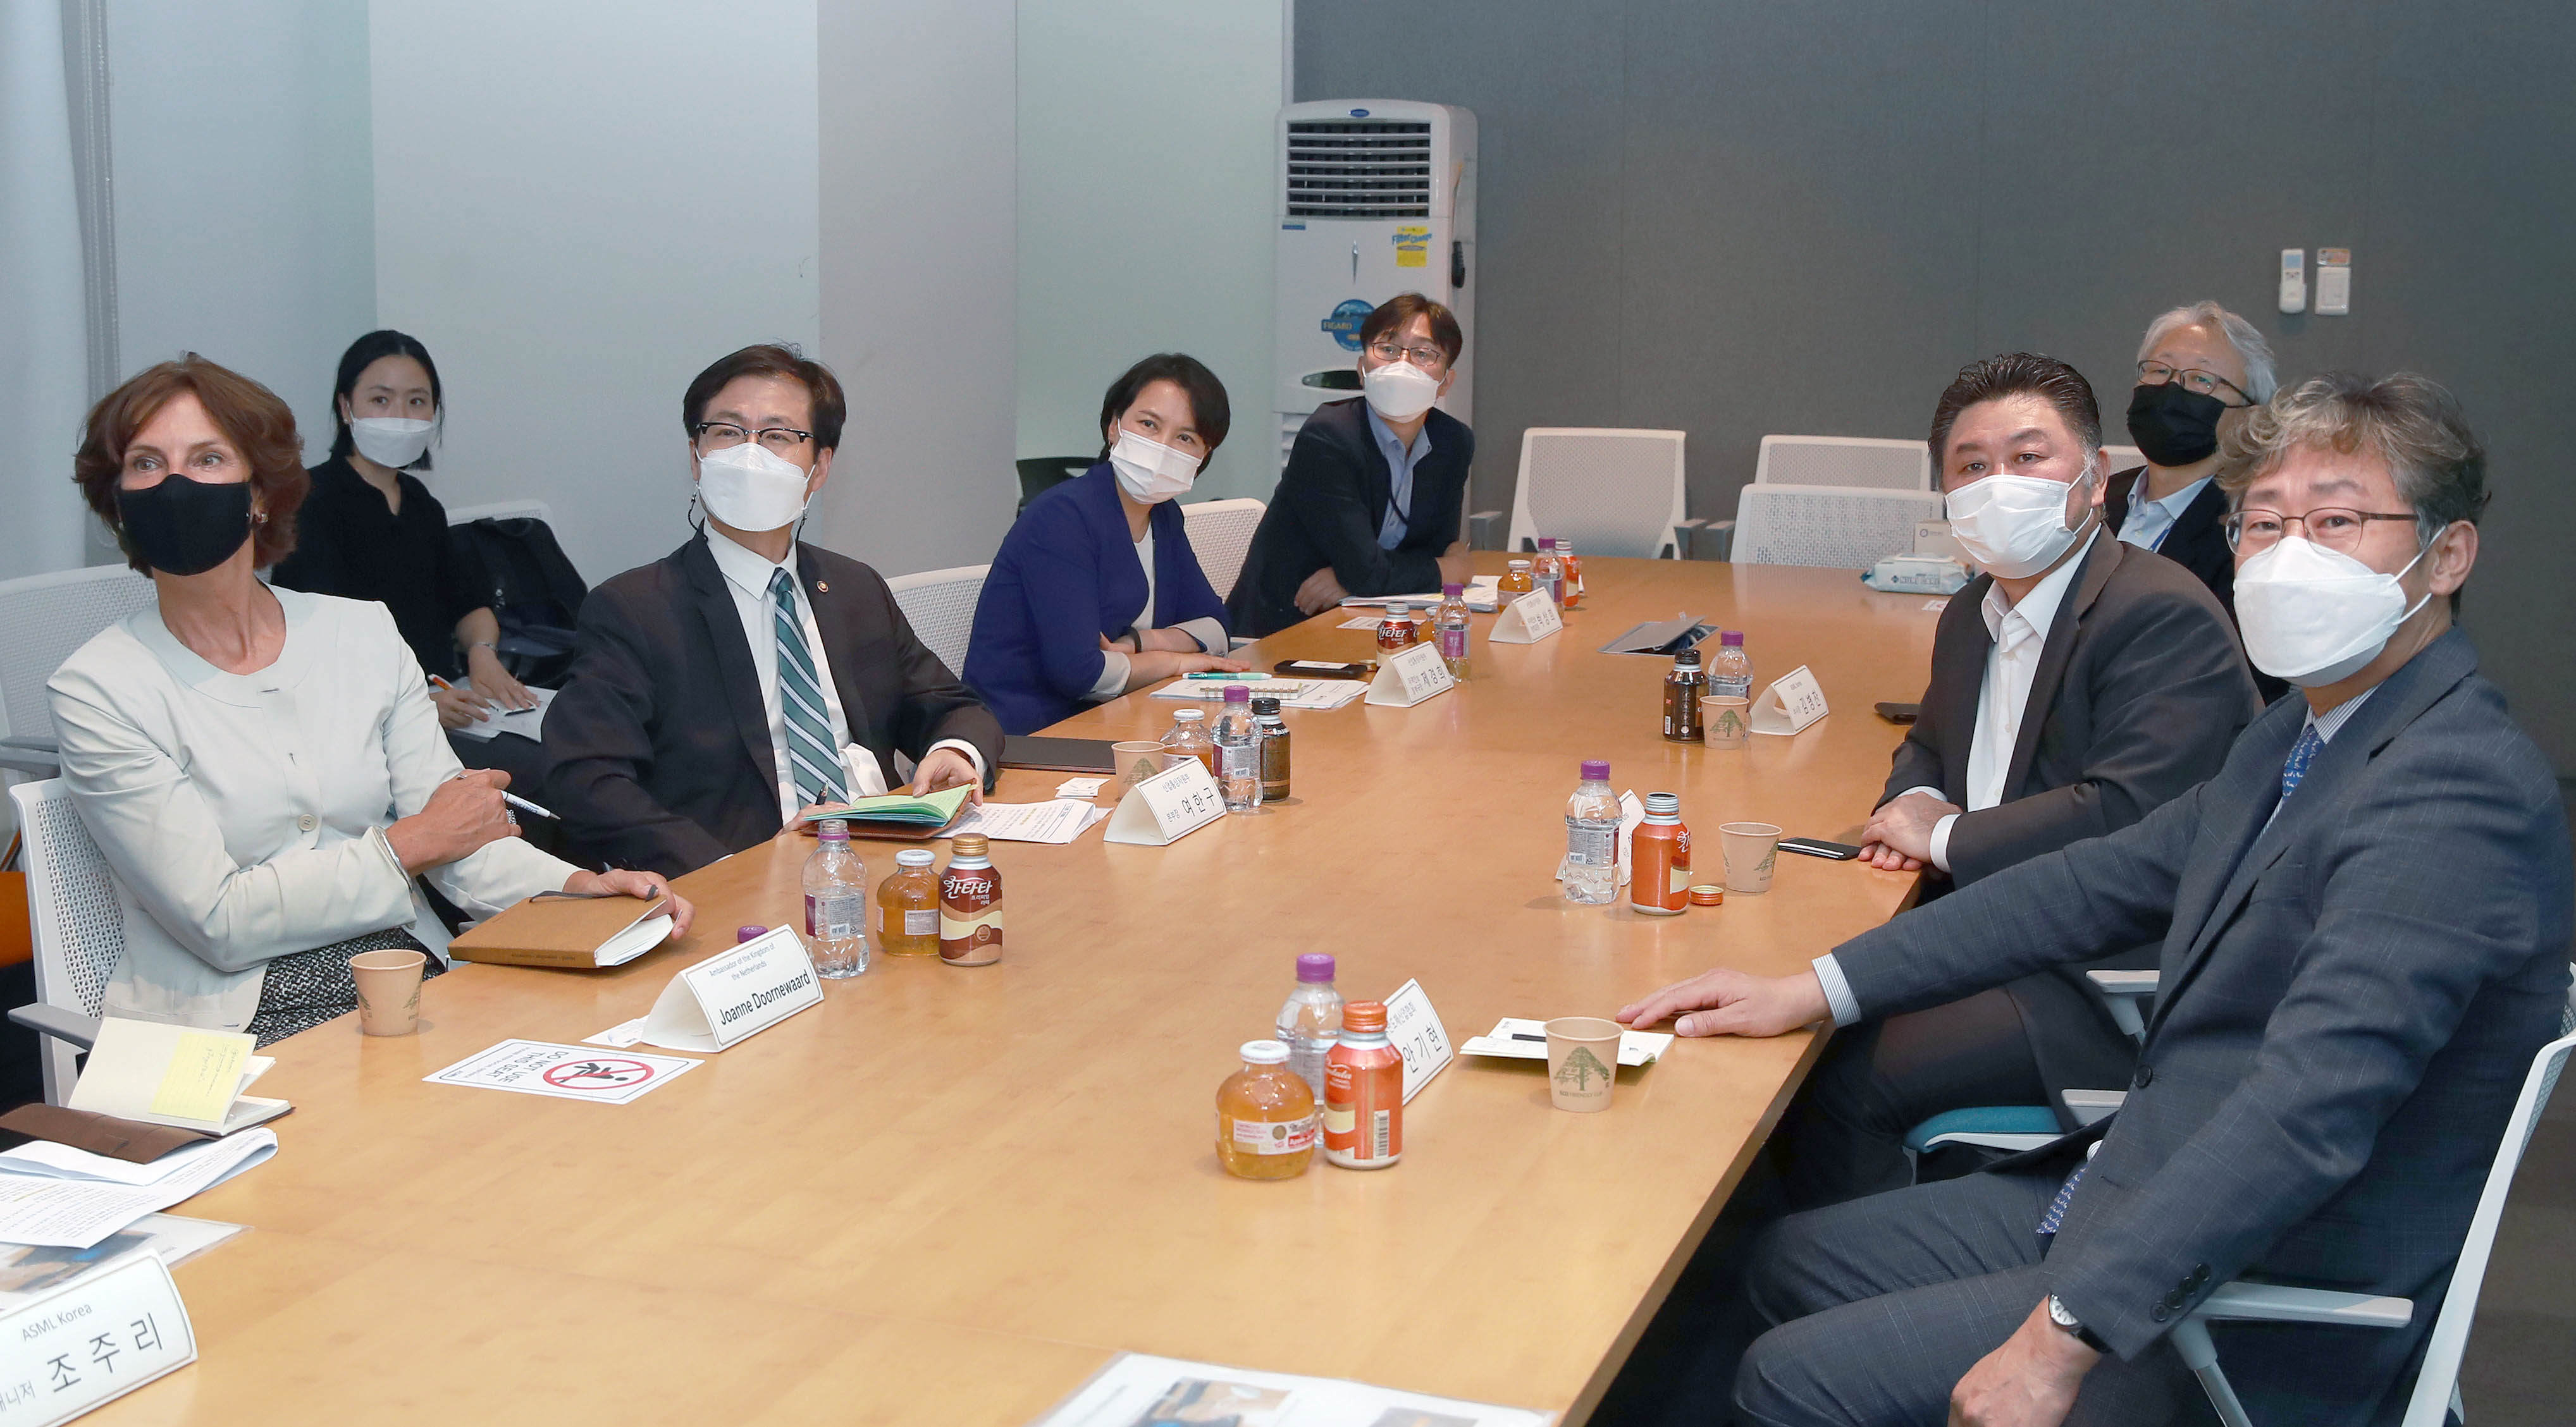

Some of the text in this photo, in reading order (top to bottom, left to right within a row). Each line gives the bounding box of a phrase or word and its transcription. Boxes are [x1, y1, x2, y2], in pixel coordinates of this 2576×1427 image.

[1181, 787, 1215, 817] 여한구
[943, 875, 993, 899] 칸타타
[709, 960, 737, 977] Ambassador
[750, 946, 770, 957] Kingdom
[739, 960, 767, 976] Netherlands
[719, 969, 811, 1026] Joanne Doornewaard
[514, 1051, 546, 1063] THIS
[1402, 1021, 1442, 1074] 안기현
[486, 1063, 519, 1078] SEAT
[498, 1051, 569, 1082] DO NOT USE
[22, 1304, 92, 1341] ASML Korea
[47, 1313, 163, 1393] 조주리
